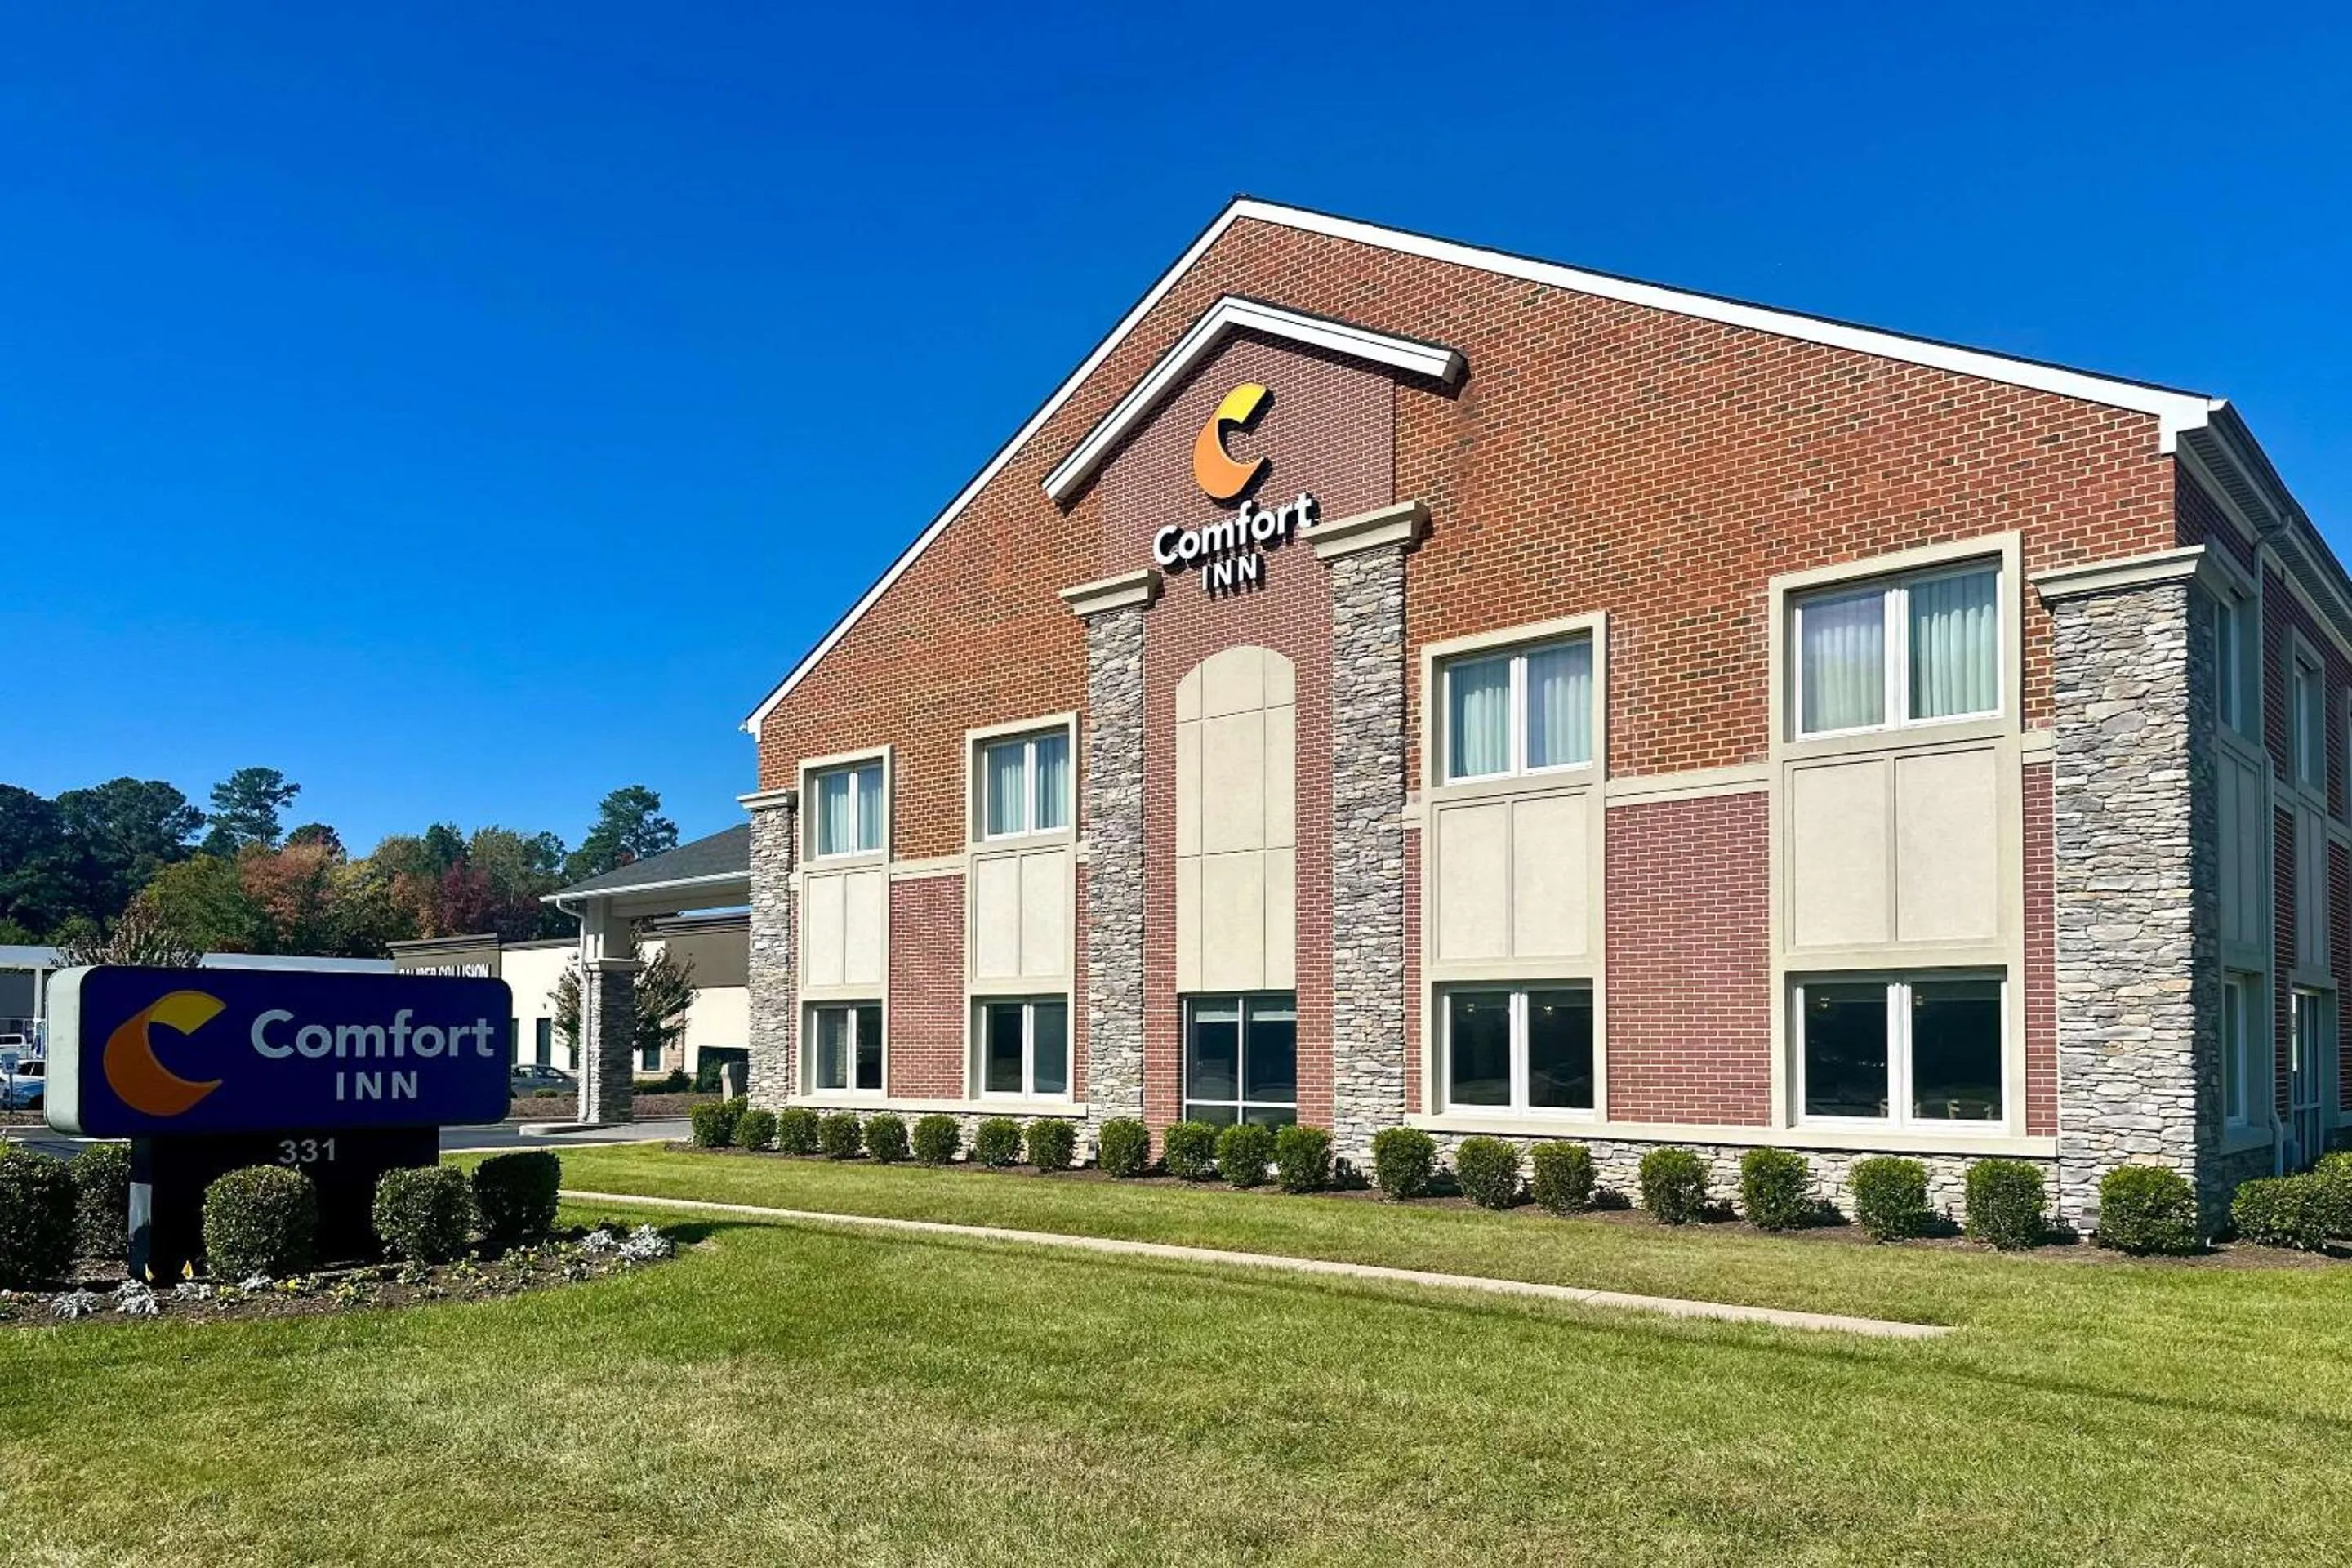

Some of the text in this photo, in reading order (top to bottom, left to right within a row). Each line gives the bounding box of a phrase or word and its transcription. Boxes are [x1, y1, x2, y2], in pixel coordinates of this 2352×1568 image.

[1153, 492, 1312, 565] Comfort
[1202, 553, 1257, 590] INN
[251, 1009, 495, 1058] Comfort
[336, 1071, 417, 1100] INN
[278, 1138, 336, 1164] 331
